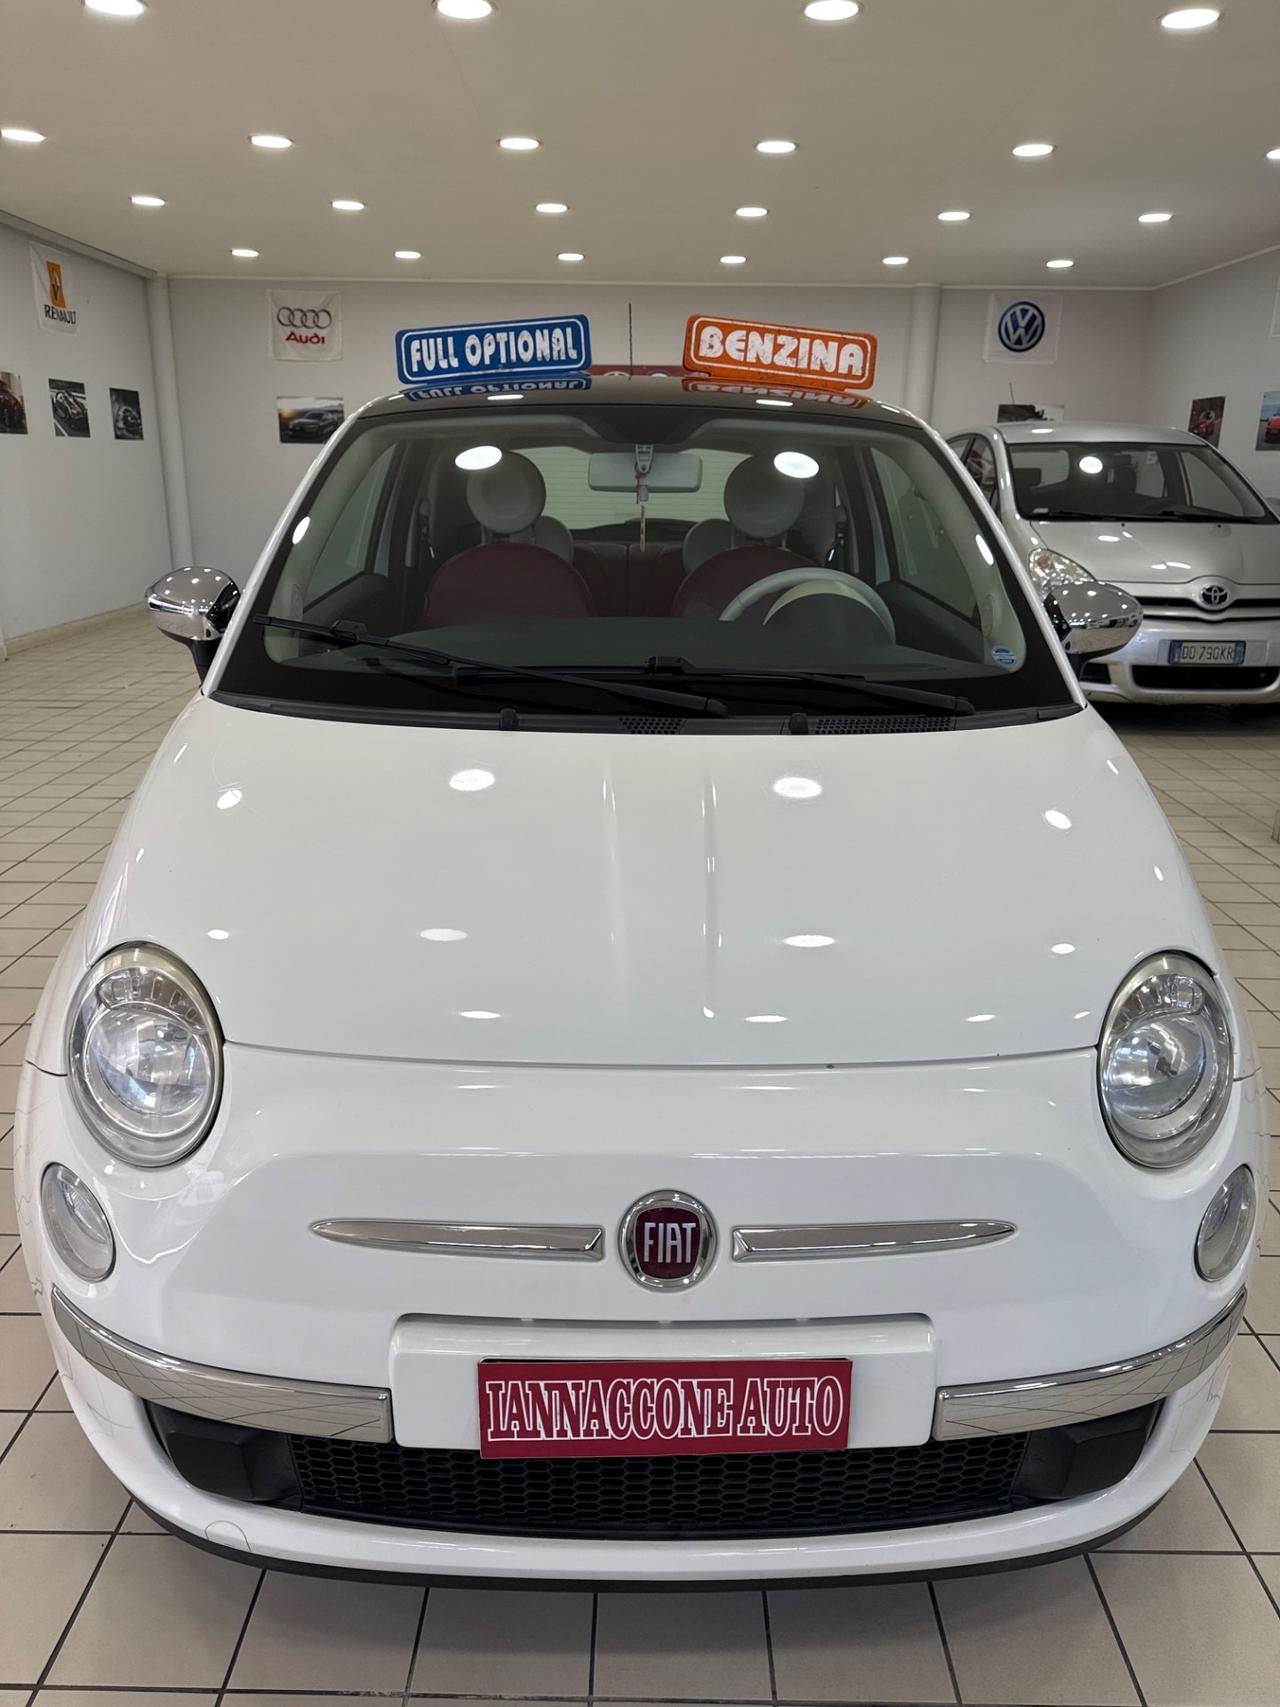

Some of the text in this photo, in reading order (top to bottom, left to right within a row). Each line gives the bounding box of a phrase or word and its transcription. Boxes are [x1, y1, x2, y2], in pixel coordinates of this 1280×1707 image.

[286, 331, 325, 345] Audi
[411, 327, 577, 372] FULL OPTIONAL
[699, 326, 864, 375] BENZINA
[643, 1221, 697, 1264] FIAT
[486, 1374, 845, 1442] IANNACCONE AUTO
